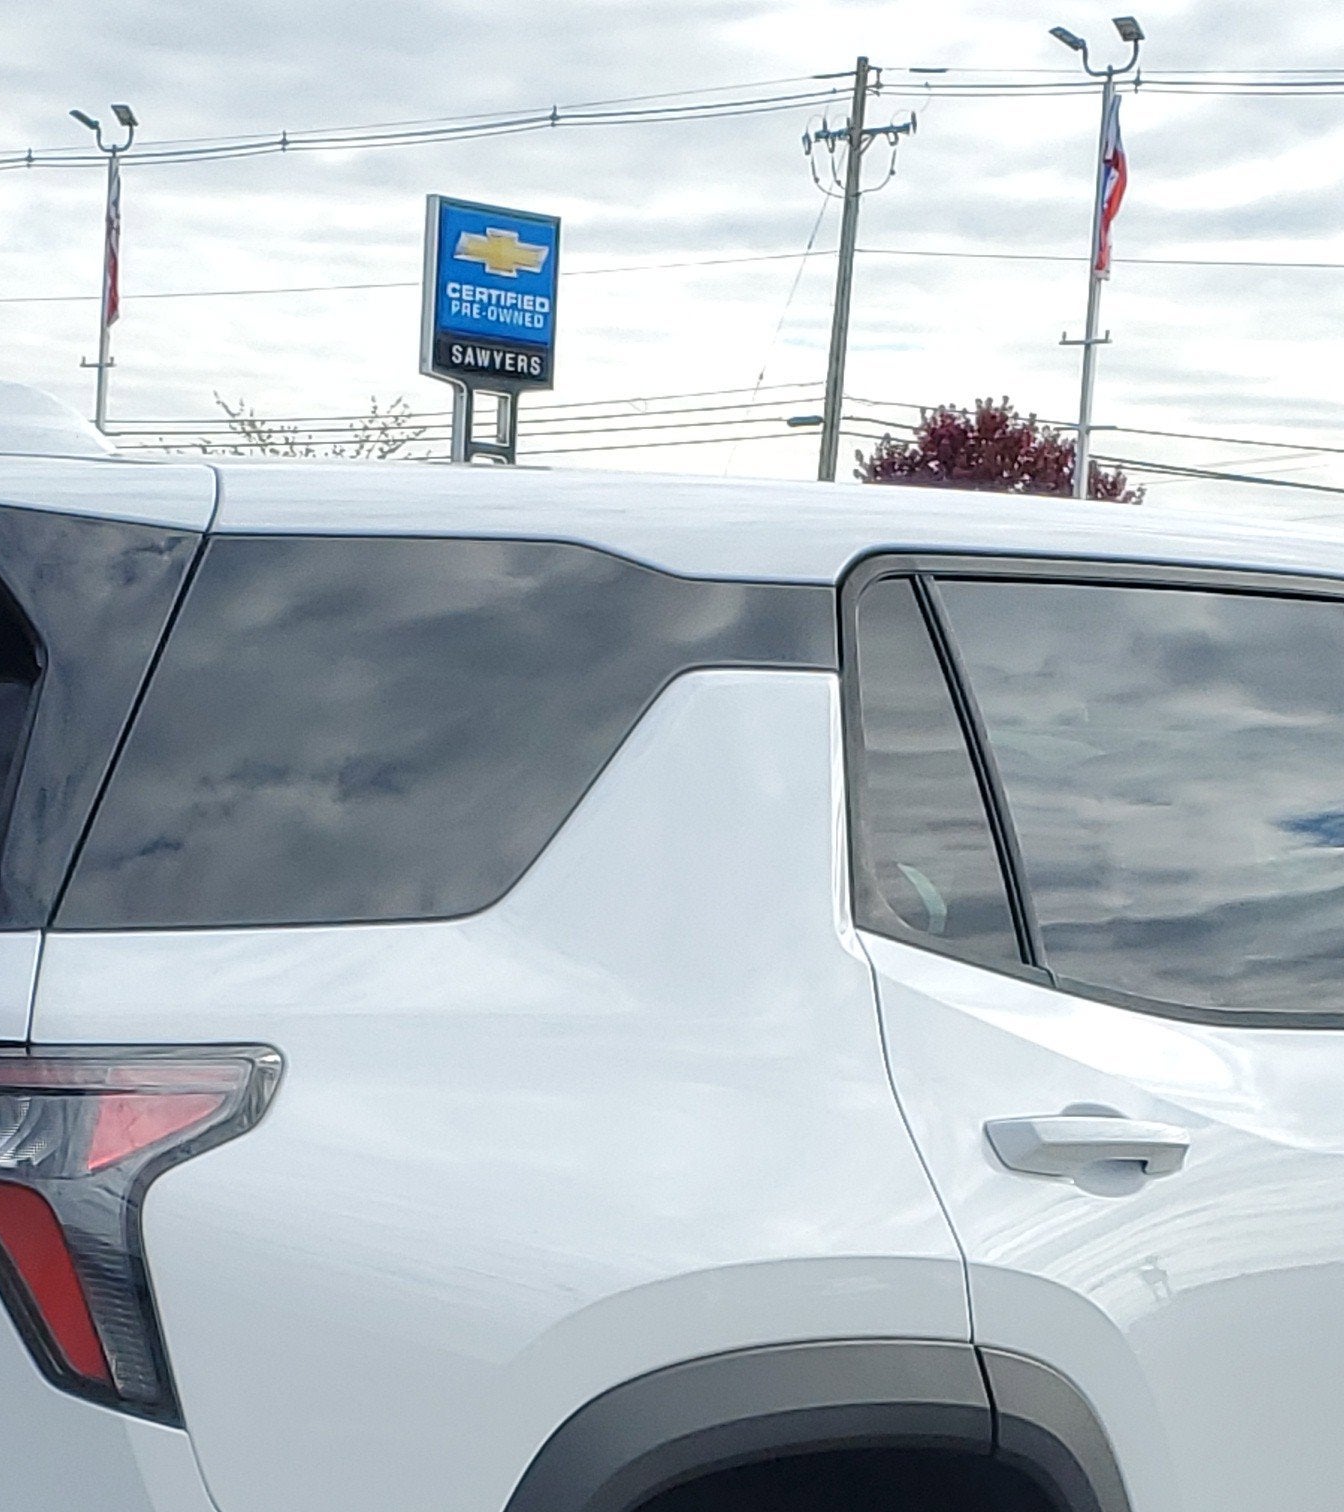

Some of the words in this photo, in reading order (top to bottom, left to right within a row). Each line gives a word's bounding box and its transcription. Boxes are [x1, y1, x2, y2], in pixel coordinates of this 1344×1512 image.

[446, 282, 550, 313] CERTIFIED
[451, 301, 544, 328] PRE-OWNED
[451, 345, 542, 375] SAWYERS
